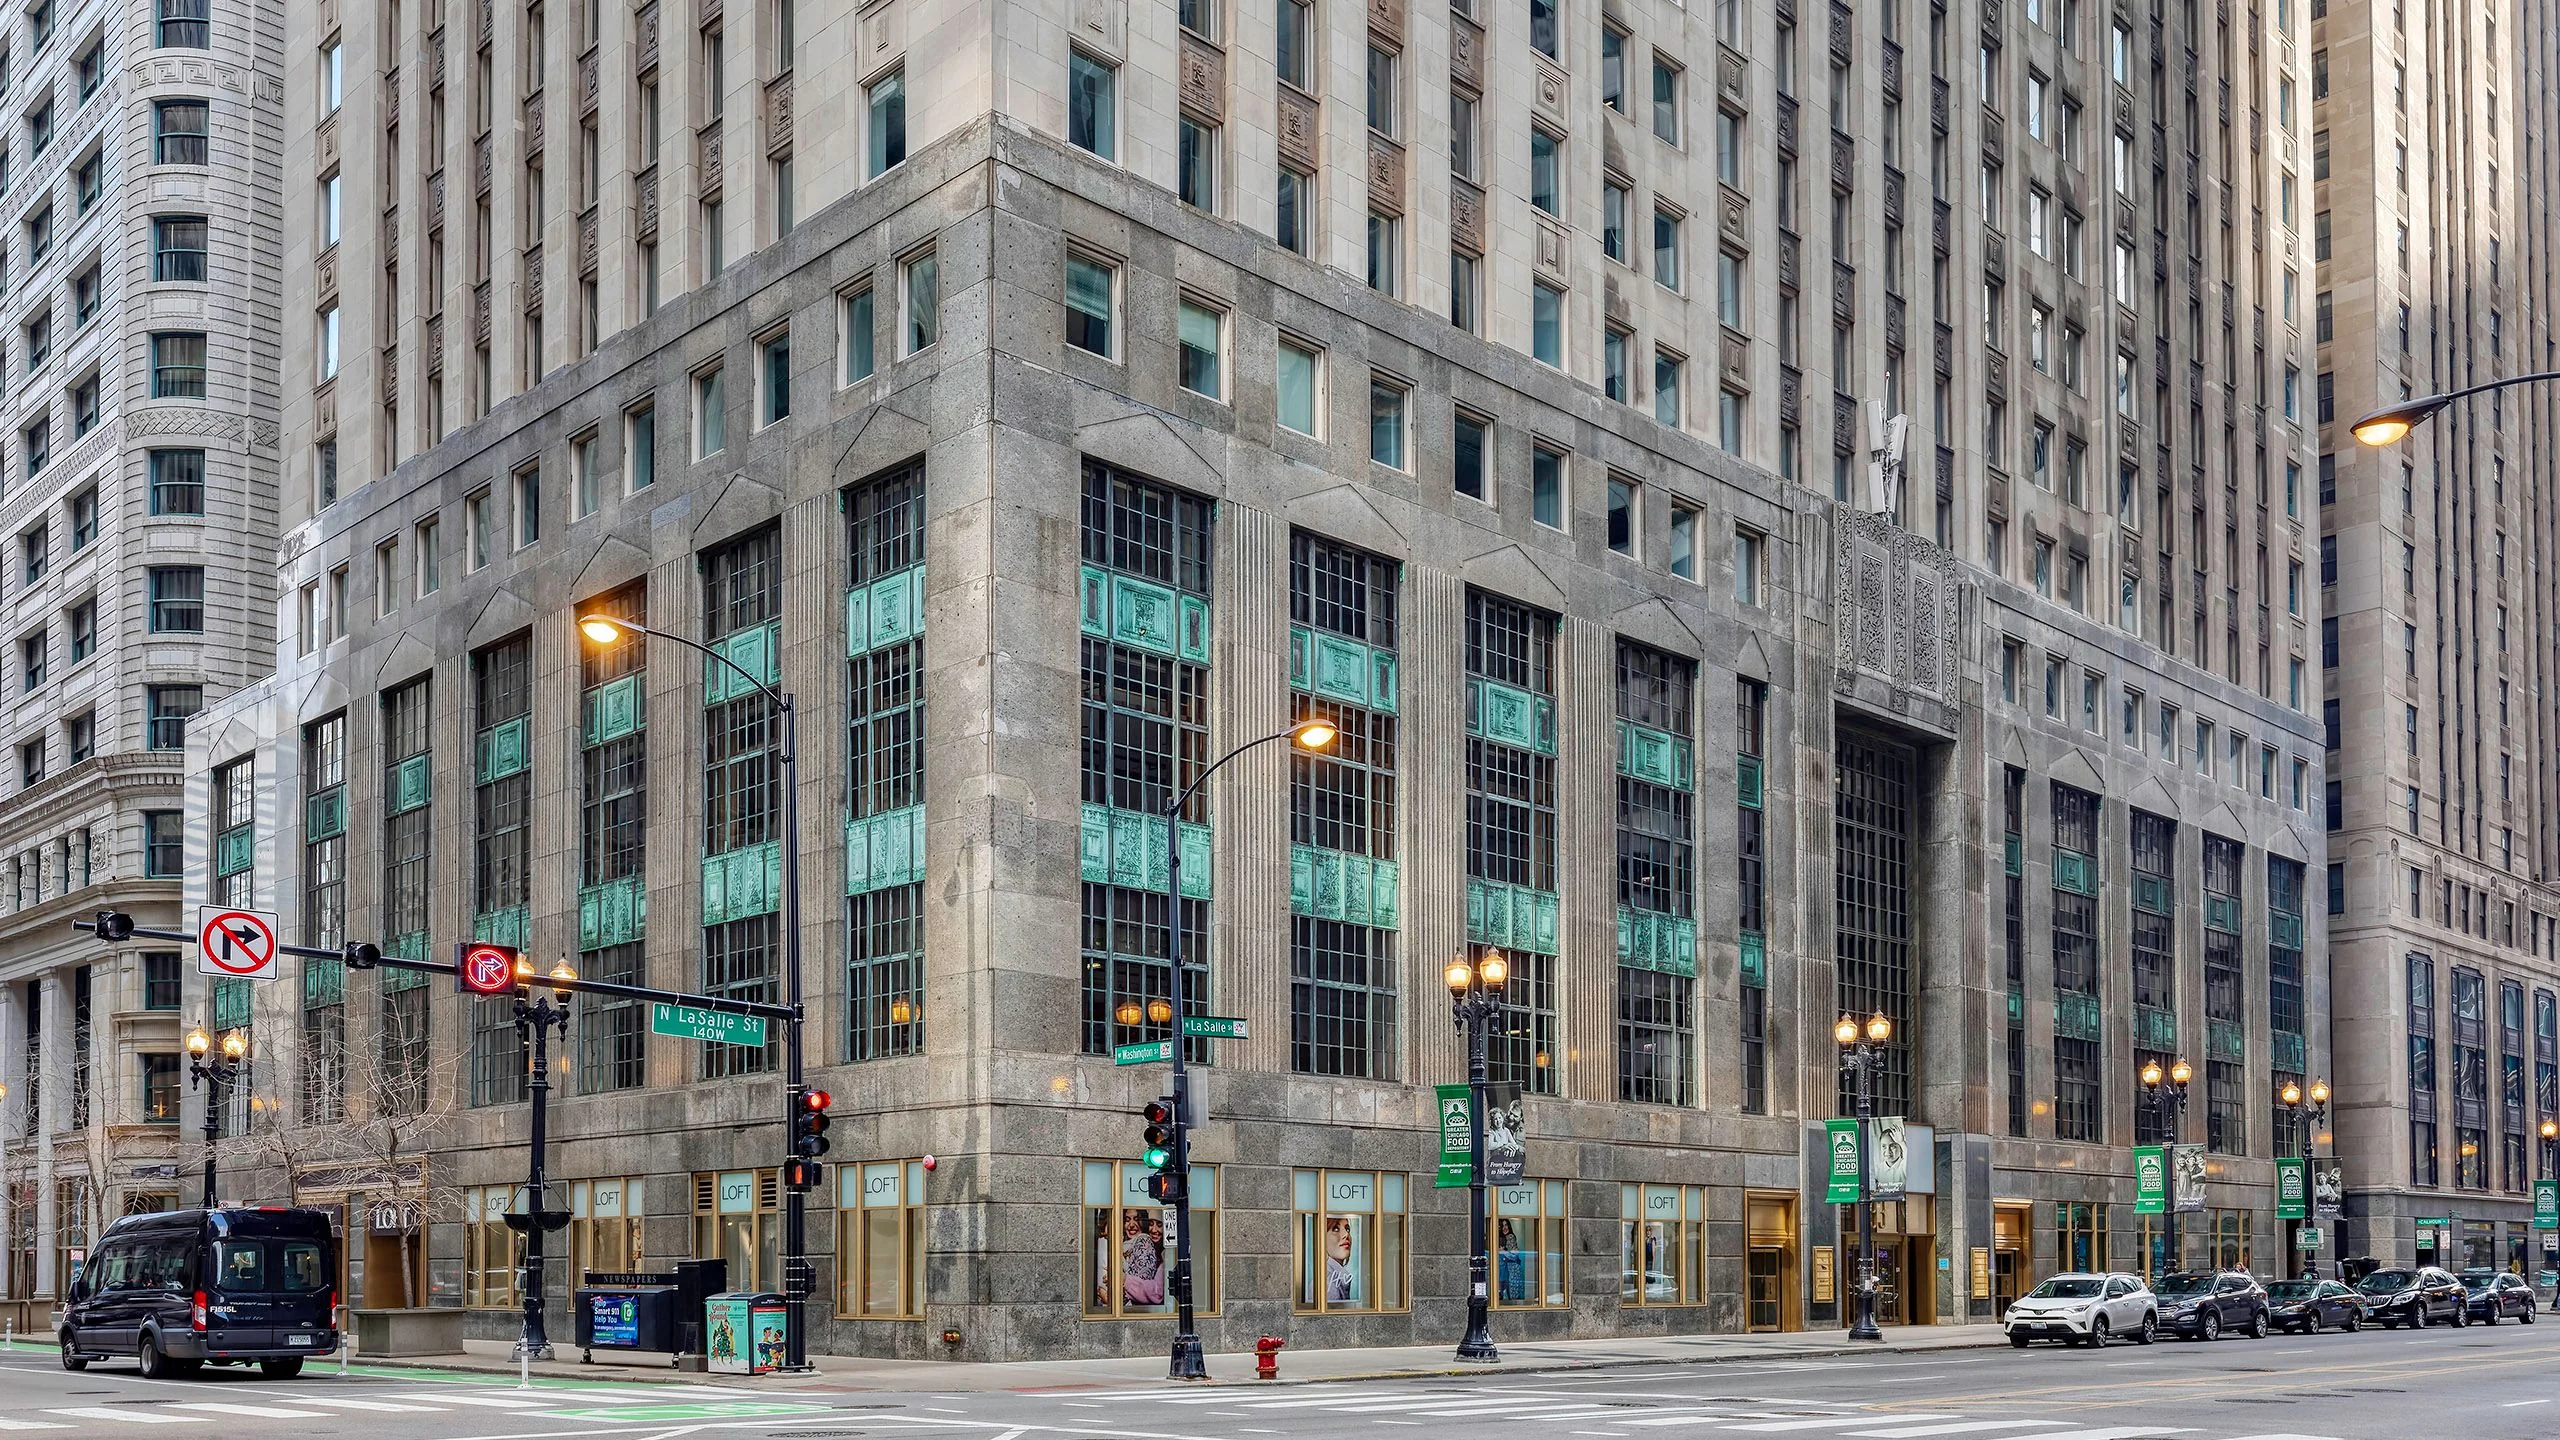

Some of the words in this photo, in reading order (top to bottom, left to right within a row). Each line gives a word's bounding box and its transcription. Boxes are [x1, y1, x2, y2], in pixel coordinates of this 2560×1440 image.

[661, 1006, 670, 1021] N
[679, 1008, 735, 1030] LaSalle
[743, 1017, 758, 1033] St
[1191, 1020, 1202, 1032] La
[1204, 1020, 1227, 1033] Salle
[692, 1026, 726, 1041] 140W
[1122, 1047, 1154, 1061] Washington
[1447, 1137, 1470, 1147] FOOD
[1503, 1161, 1522, 1169] Hungry
[1836, 1162, 1856, 1170] FOOD
[722, 1184, 751, 1201] LOFT
[864, 1176, 899, 1195] LOFT
[1332, 1184, 1369, 1200] LOFT
[486, 1197, 508, 1211] LOFT
[595, 1191, 620, 1206] LOFT
[1502, 1190, 1533, 1205] LOFT
[1648, 1196, 1676, 1210] LOFT
[1164, 1211, 1176, 1221] ONE
[1165, 1222, 1177, 1231] WAY
[603, 1275, 657, 1284] NEWSPAPERS
[594, 1307, 610, 1316] Smart
[594, 1315, 607, 1324] Help
[607, 1315, 618, 1324] You
